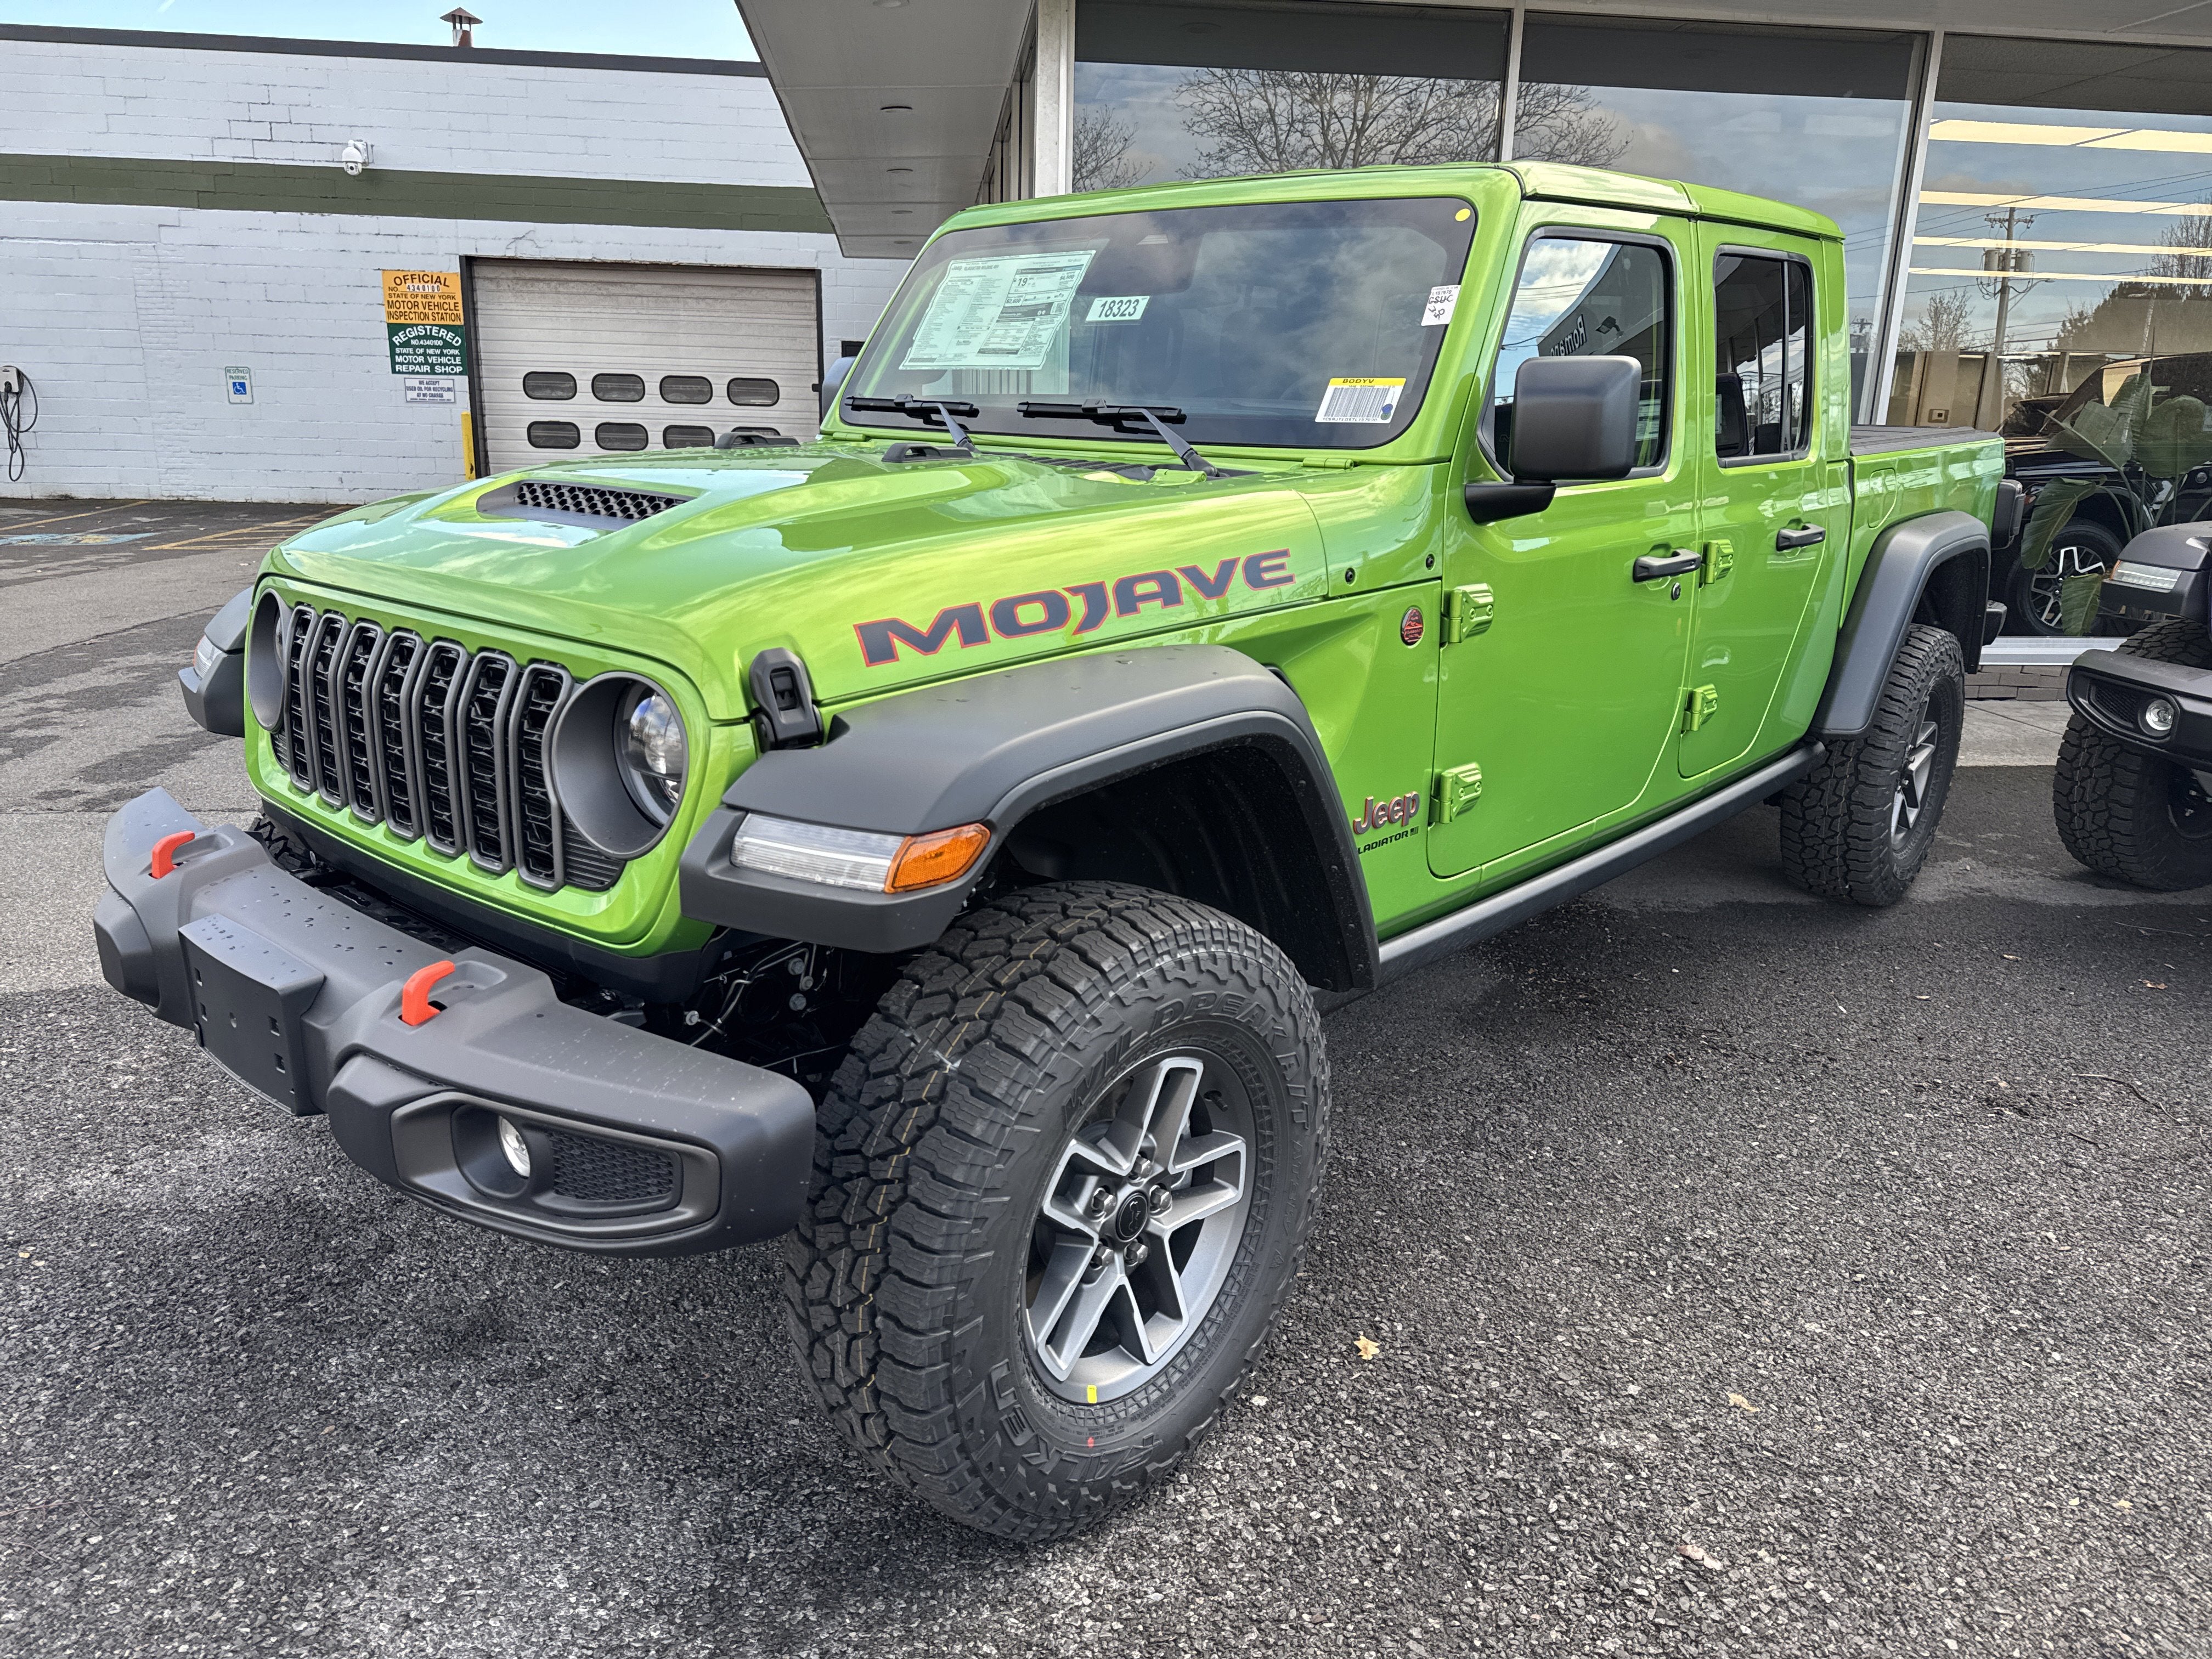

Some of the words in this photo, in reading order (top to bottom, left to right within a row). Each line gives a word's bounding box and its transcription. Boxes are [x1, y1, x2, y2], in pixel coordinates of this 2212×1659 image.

[394, 274, 450, 287] OFFICIAL
[1018, 278, 1028, 286] 19
[387, 300, 420, 310] MOTOR
[422, 301, 460, 311] VEHICLE
[1098, 299, 1139, 318] 18323
[387, 311, 430, 321] INSPECTION
[431, 312, 461, 322] STATION
[392, 325, 462, 346] REGISTERED
[396, 365, 430, 373] REPAIR
[435, 365, 463, 374] SHOP
[853, 548, 1296, 667] MOJAVE
[1353, 791, 1420, 834] Jeep
[1357, 830, 1409, 855] LADIATOR
